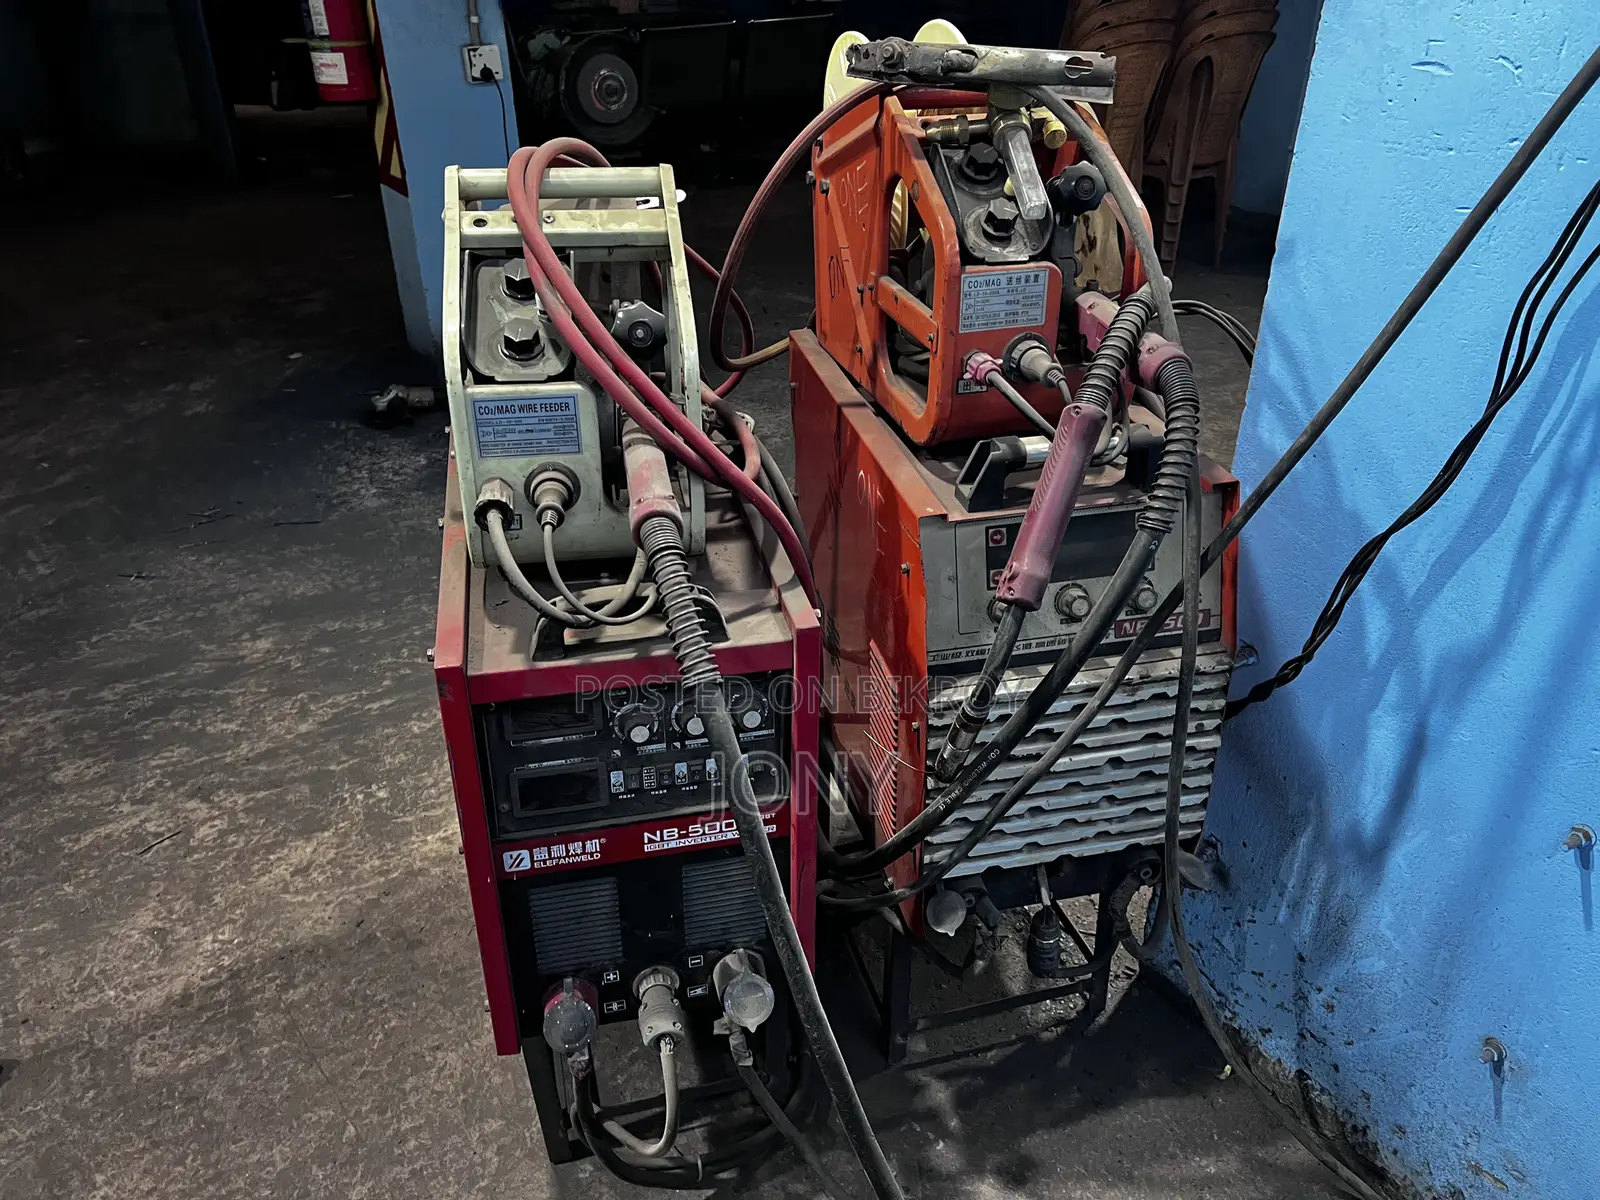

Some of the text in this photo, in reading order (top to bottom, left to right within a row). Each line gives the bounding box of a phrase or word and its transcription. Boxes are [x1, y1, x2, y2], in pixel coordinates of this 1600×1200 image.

[518, 403, 538, 414] WIRE
[540, 402, 570, 412] FEEDER
[643, 819, 737, 843] NB-500
[646, 834, 728, 850] IGBT INVERTER
[534, 853, 601, 868] ELEFANWELD
